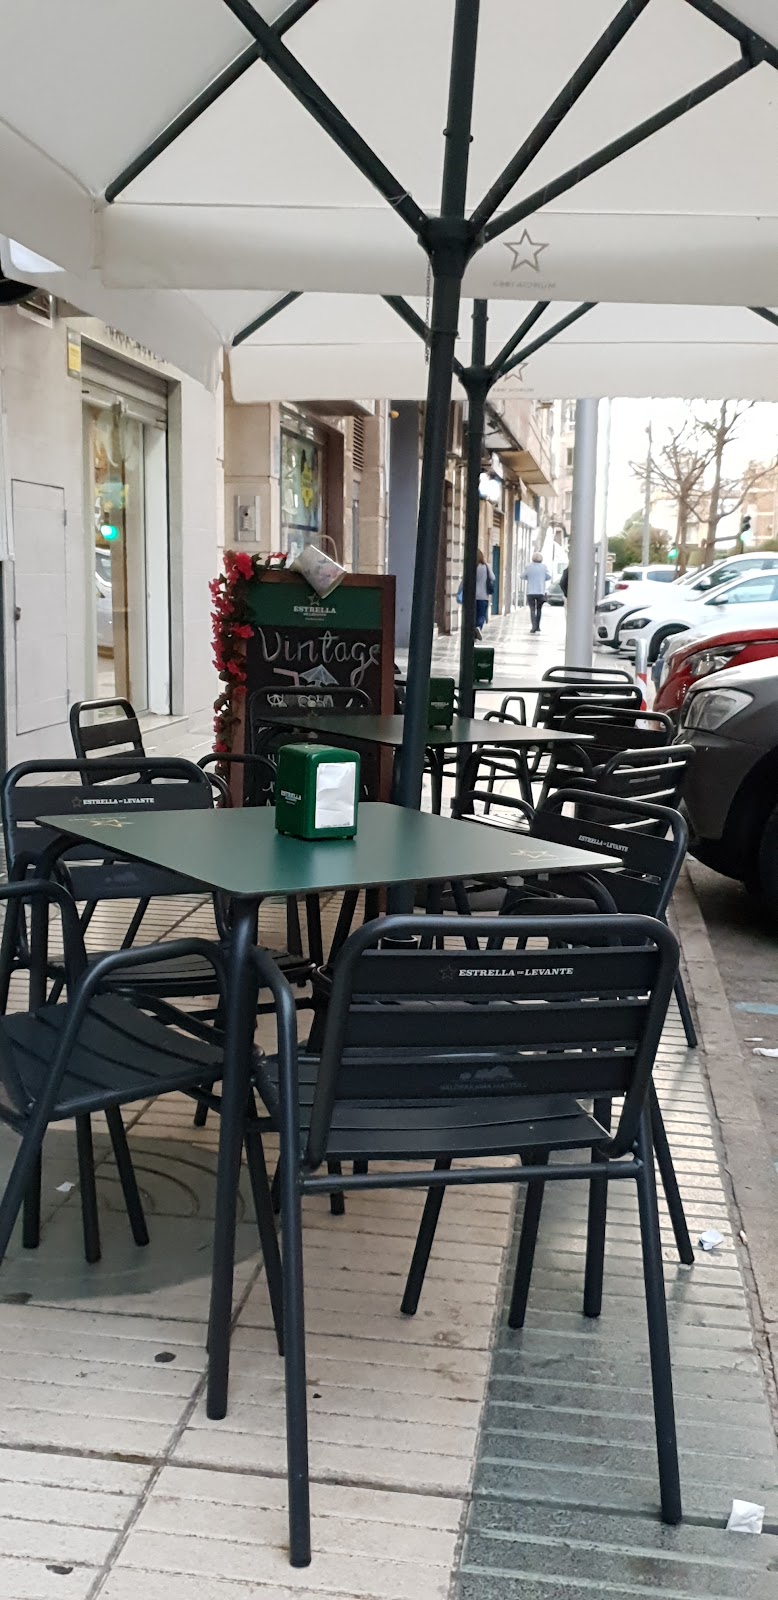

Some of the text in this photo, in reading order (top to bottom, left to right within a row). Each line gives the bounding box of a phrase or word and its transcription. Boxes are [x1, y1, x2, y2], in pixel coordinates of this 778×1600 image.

[293, 606, 336, 614] ESTRELLA
[258, 627, 381, 688] Vintage
[124, 797, 154, 805] LEVANTE
[578, 835, 603, 846] ESTRELLA
[458, 969, 515, 977] ESTRELLA
[524, 967, 574, 976] LEVANTE
